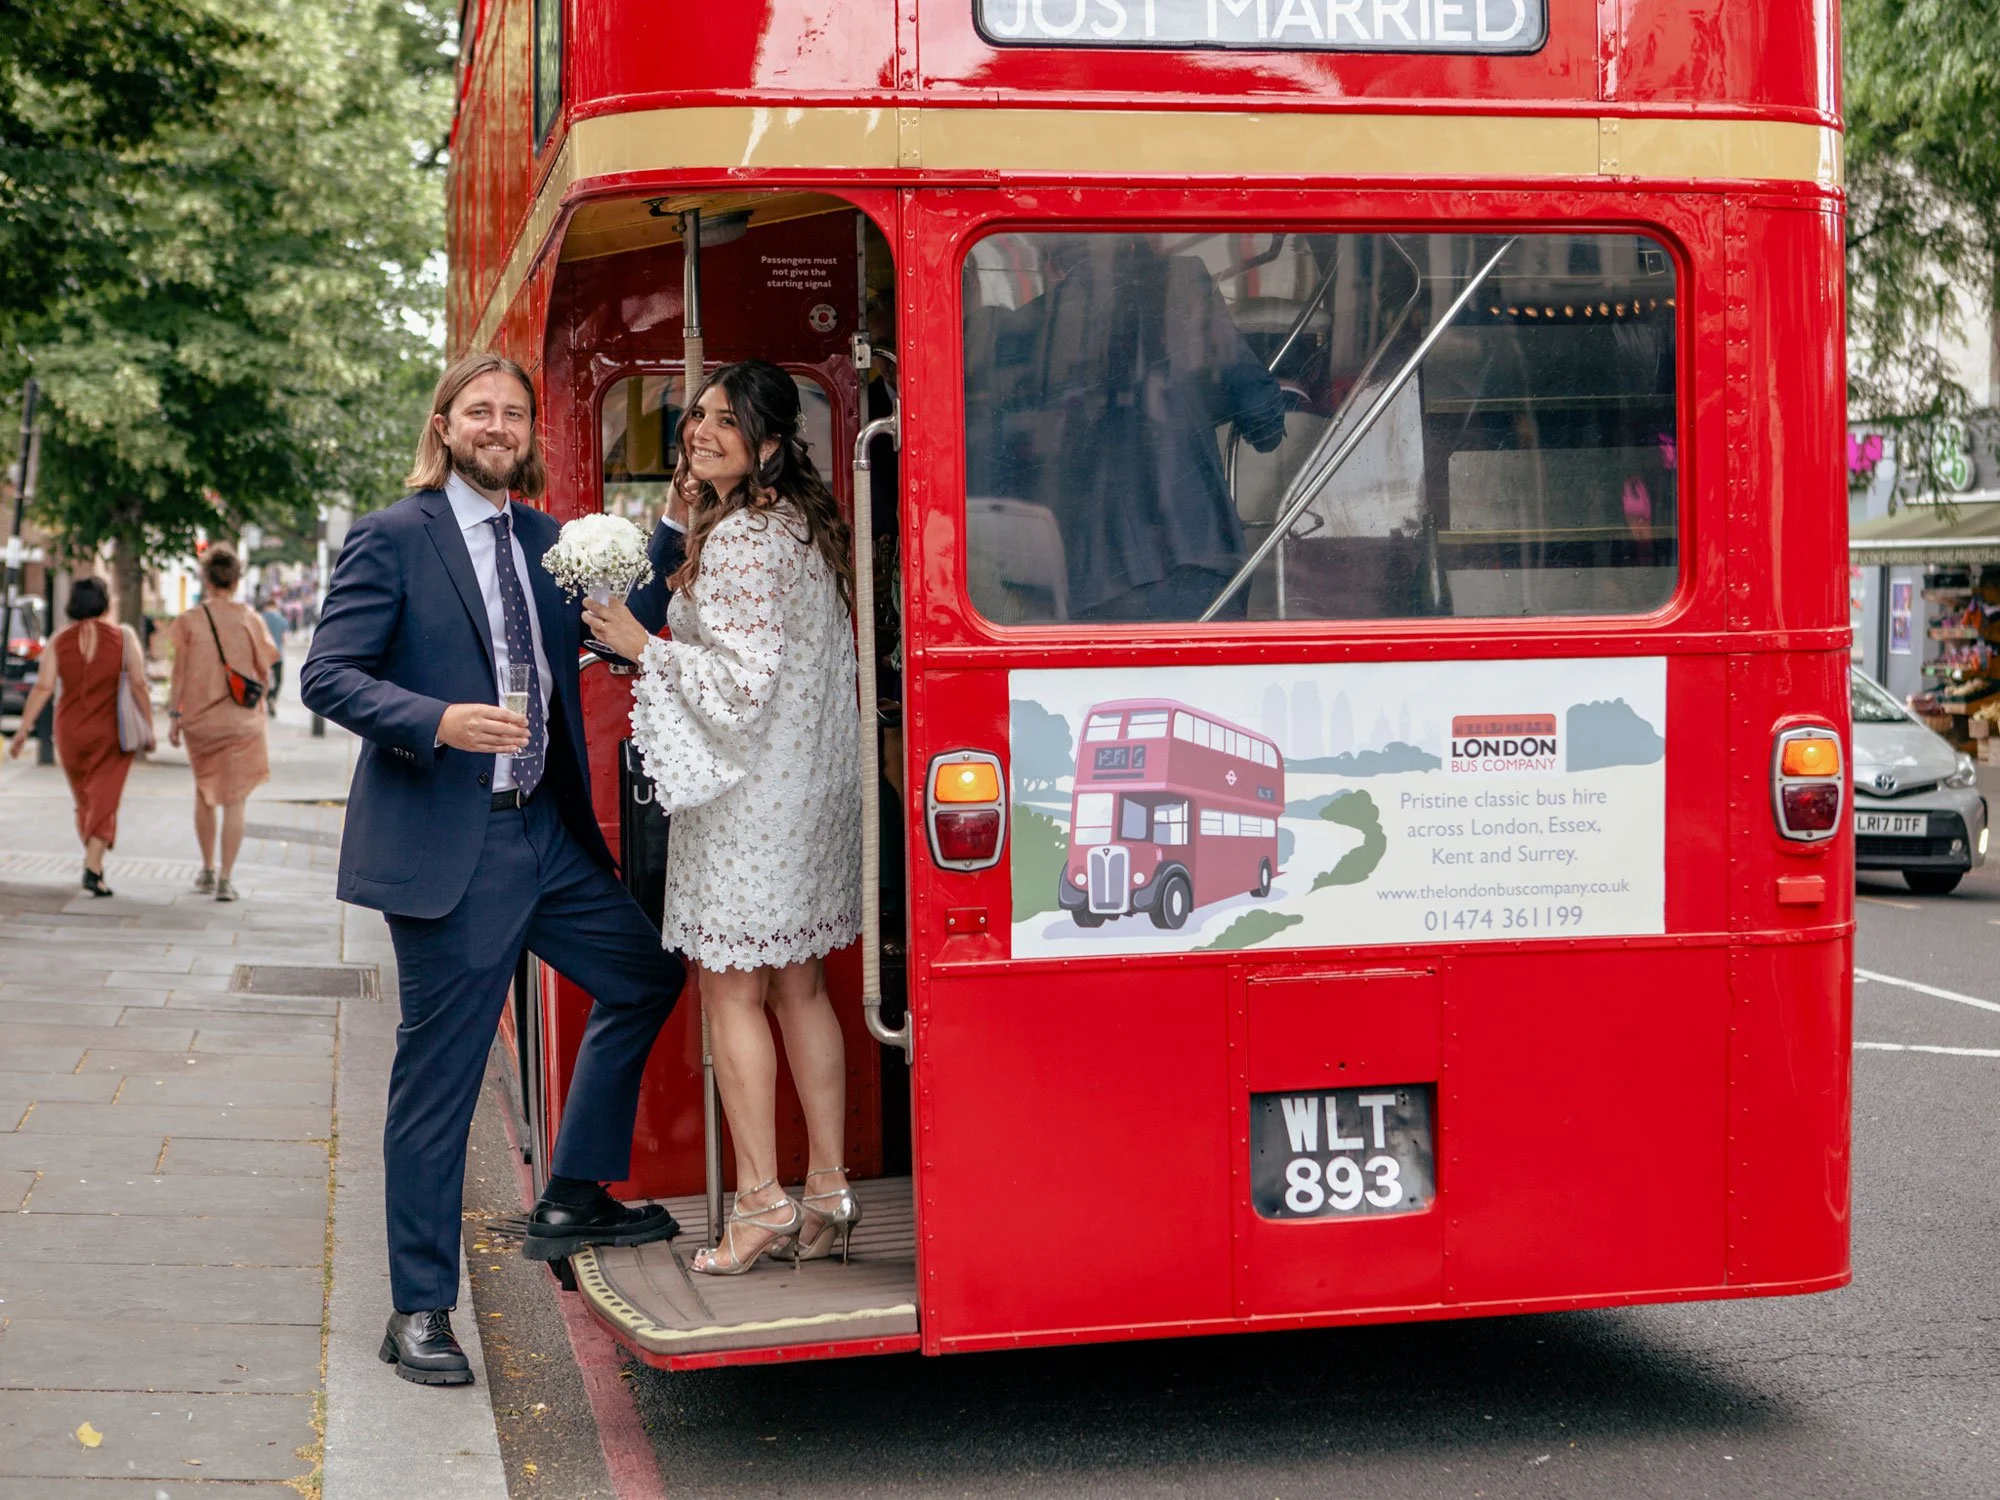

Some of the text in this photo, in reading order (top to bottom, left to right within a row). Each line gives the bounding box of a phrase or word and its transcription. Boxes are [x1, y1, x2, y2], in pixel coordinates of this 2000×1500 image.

[1207, 0, 1526, 42] MARRIED
[761, 256, 811, 266] Passengers
[772, 268, 826, 278] not give the
[767, 280, 832, 290] starting signal
[1452, 738, 1556, 758] LONDON
[1451, 758, 1556, 772] BUS COMPANY
[1400, 788, 1607, 809] Pristine classic bus hire
[1407, 816, 1601, 838] across London, Essex,
[1857, 816, 1921, 832] LR17 DTF
[1432, 846, 1578, 866] Kent and Surrey.
[1376, 878, 1630, 901] www.thelondonbuscompany.co.uk
[1424, 905, 1583, 931] 01474 361199
[1280, 1094, 1396, 1152] WLT
[1285, 1155, 1403, 1212] 893
